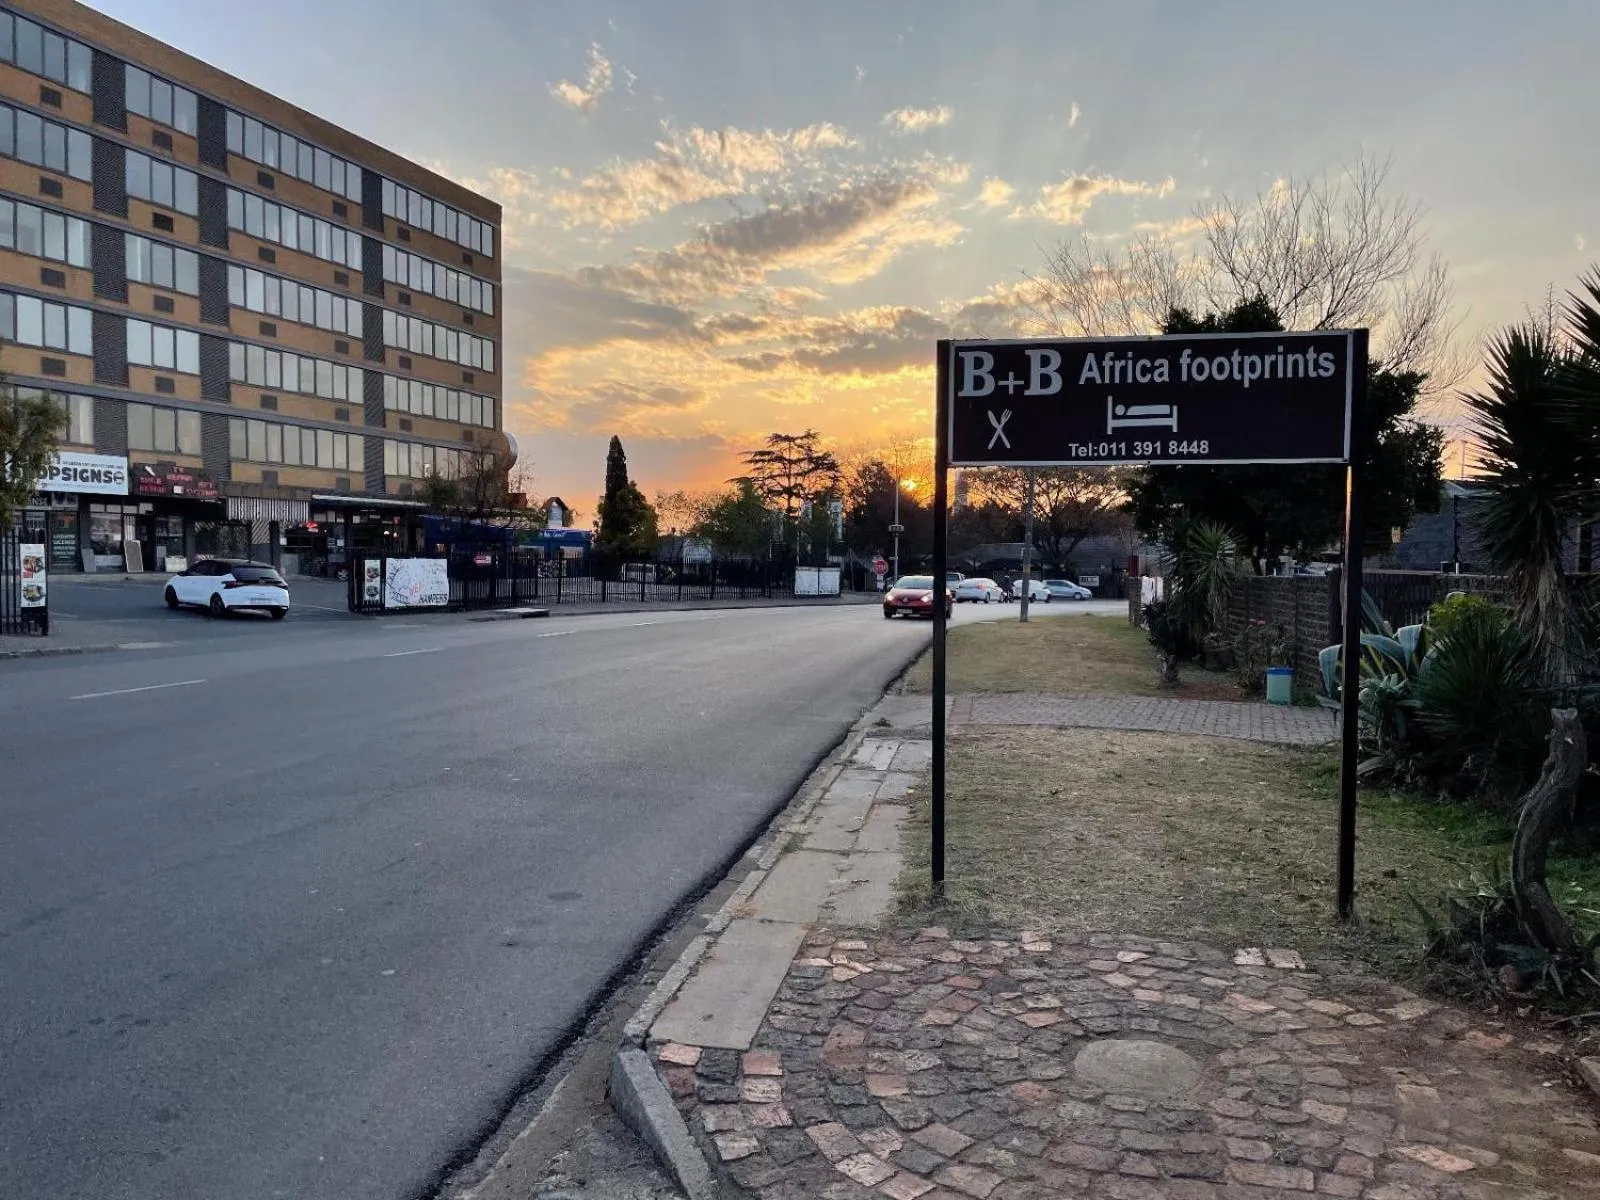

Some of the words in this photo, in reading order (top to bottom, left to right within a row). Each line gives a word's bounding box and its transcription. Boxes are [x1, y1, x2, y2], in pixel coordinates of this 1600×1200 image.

[958, 349, 1063, 398] B+B
[1079, 352, 1169, 384] Africa
[1180, 345, 1336, 388] footprints
[1068, 441, 1127, 458] Tel:011
[1133, 440, 1162, 456] 391
[1168, 439, 1210, 455] 8448
